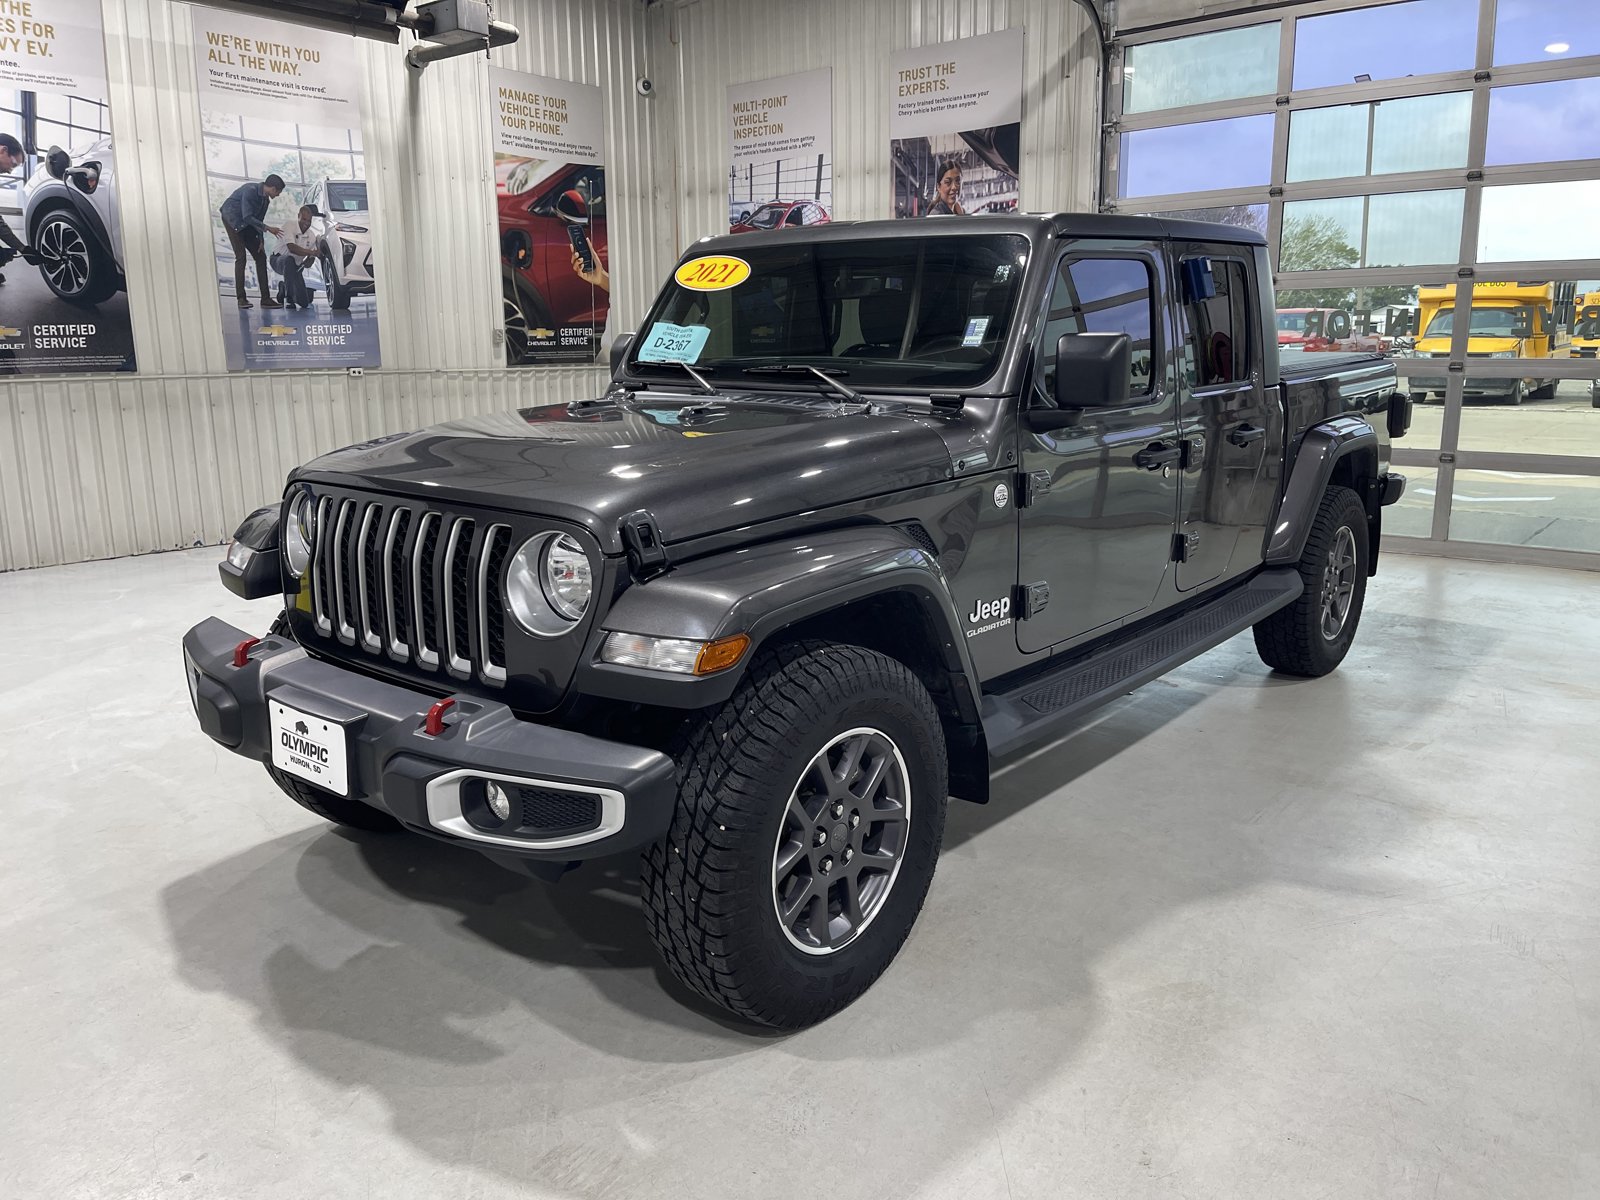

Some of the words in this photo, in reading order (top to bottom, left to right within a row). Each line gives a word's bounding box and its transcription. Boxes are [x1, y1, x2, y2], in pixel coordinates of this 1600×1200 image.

[0, 0, 32, 17] THE
[22, 20, 55, 39] FOR
[27, 40, 53, 57] EV.
[255, 40, 291, 59] WITH
[294, 47, 320, 63] YOU
[208, 48, 235, 65] ALL
[239, 53, 266, 71] THE
[269, 59, 301, 76] WAY.
[209, 68, 224, 77] Your
[225, 71, 240, 80] first
[240, 75, 280, 87] maintenance
[281, 81, 294, 89] visit
[898, 66, 932, 82] TRUST
[935, 62, 956, 76] THE
[898, 79, 950, 97] EXPERTS.
[935, 96, 962, 104] technicians
[977, 90, 990, 98] your
[498, 86, 540, 105] MANAGE
[542, 95, 567, 110] YOUR
[733, 95, 788, 114] MULTI-POINT
[499, 101, 540, 119] VEHICLE
[543, 109, 568, 123] FROM
[733, 112, 768, 127] VEHICLE
[913, 107, 930, 115] vehicle
[500, 115, 526, 130] YOUR
[529, 121, 564, 136] PHONE.
[733, 123, 784, 140] INSPECTION
[683, 263, 740, 283] 2021
[33, 324, 96, 336] CERTIFIED
[305, 324, 353, 335] CERTIFIED
[559, 327, 593, 337] CERTIFIED
[34, 337, 87, 349] SERVICE
[306, 335, 346, 346] SERVICE
[560, 336, 588, 346] SERVICE
[654, 337, 691, 351] D-2367
[968, 596, 1010, 623] Jeep
[966, 618, 1011, 638] GLADIATOR
[281, 731, 328, 763] OLYMPIC
[290, 755, 312, 771] HURON,
[312, 764, 321, 774] SD
